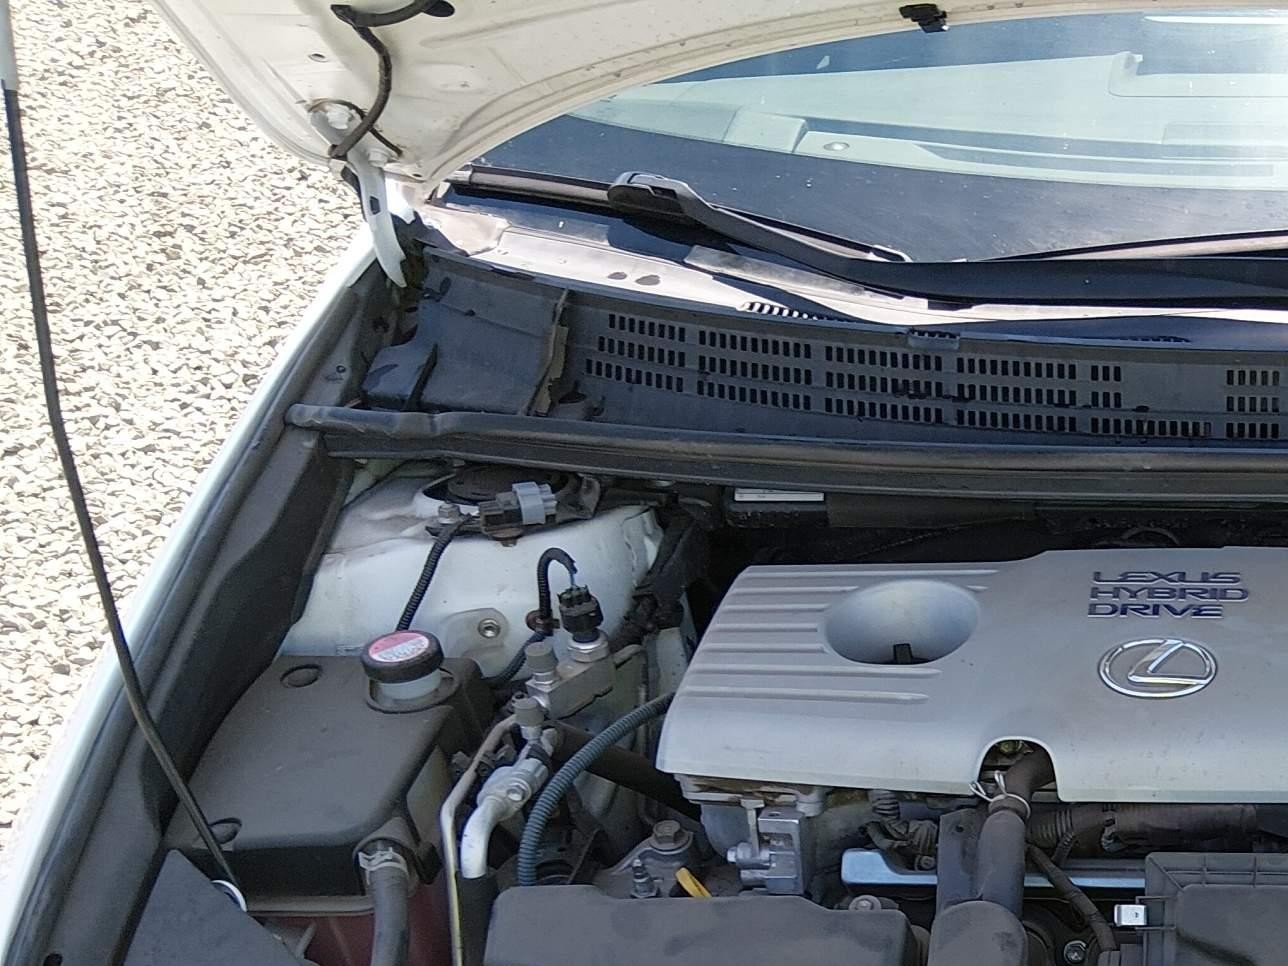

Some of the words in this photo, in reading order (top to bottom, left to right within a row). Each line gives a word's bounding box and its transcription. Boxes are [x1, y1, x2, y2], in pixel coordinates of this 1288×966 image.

[1092, 571, 1241, 586] LEXUS
[1090, 586, 1249, 602] HYBRID
[1088, 603, 1224, 619] DRIVE
